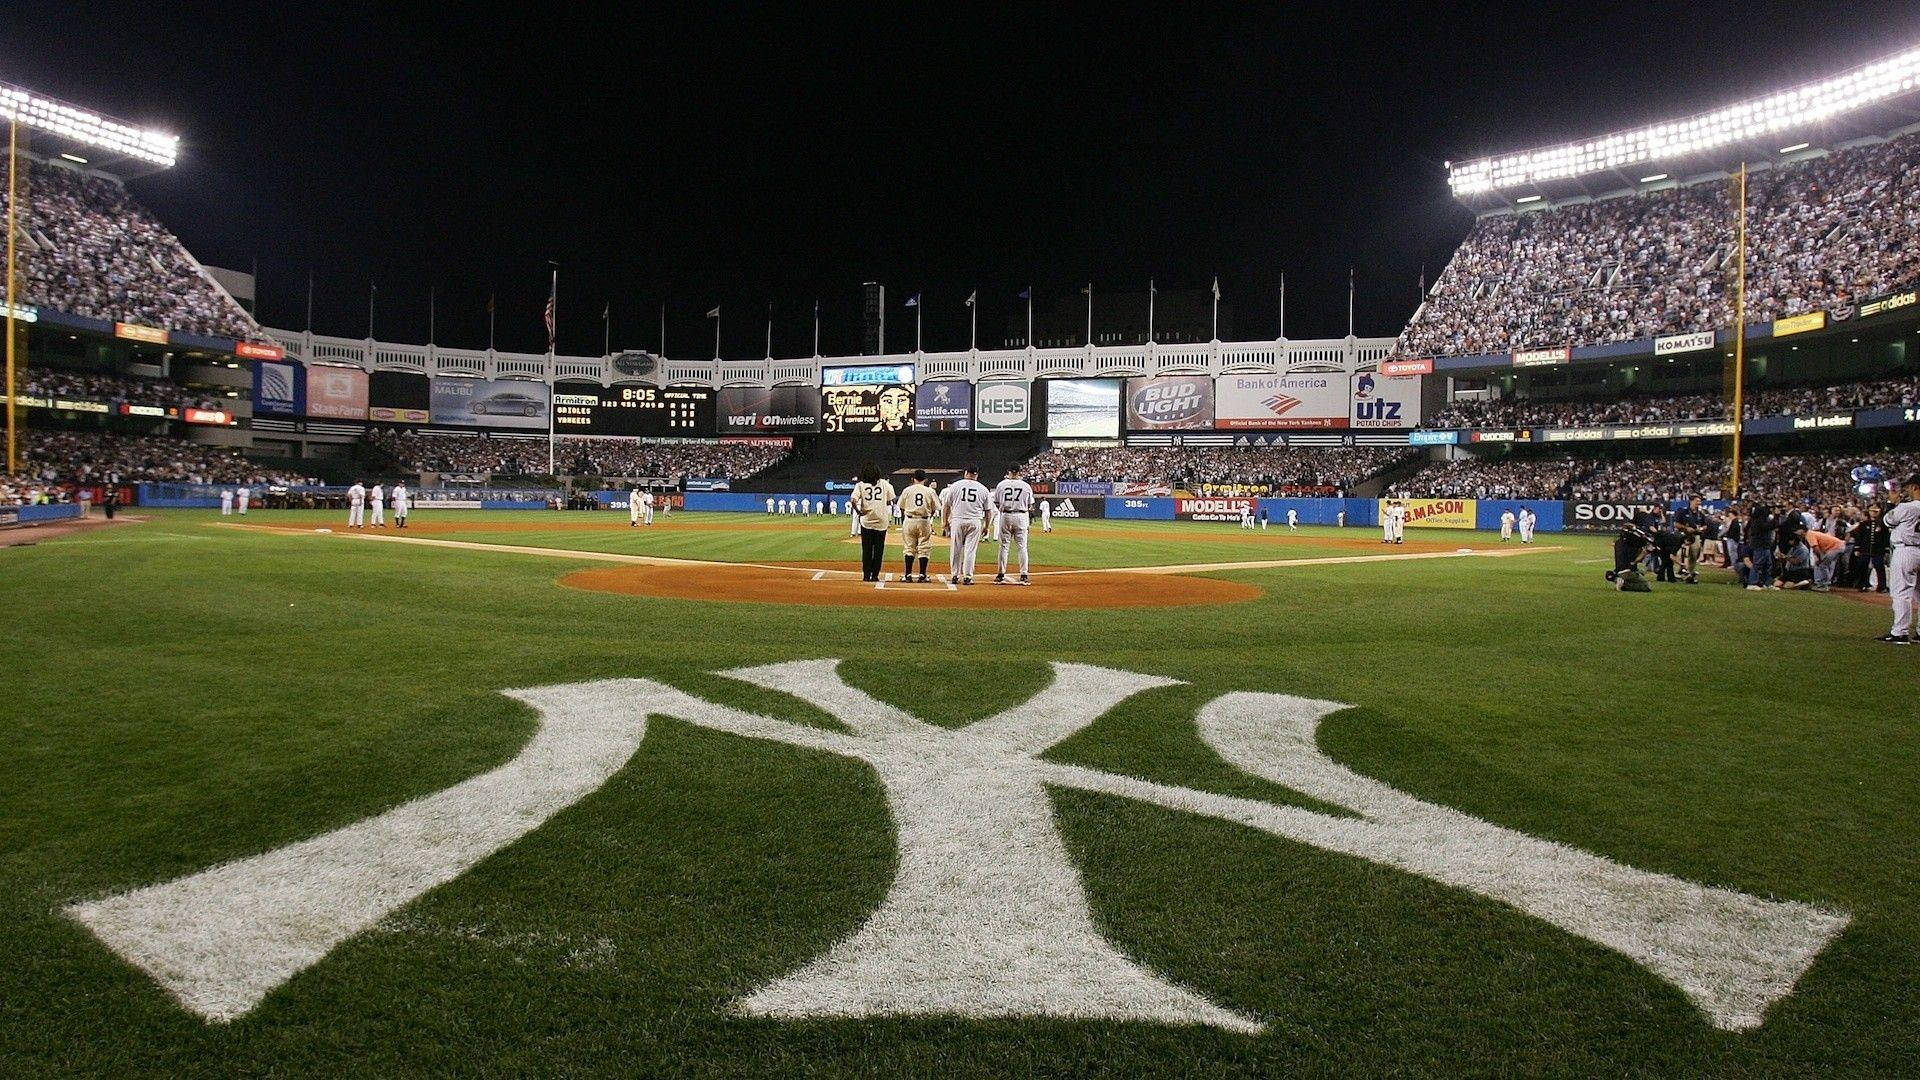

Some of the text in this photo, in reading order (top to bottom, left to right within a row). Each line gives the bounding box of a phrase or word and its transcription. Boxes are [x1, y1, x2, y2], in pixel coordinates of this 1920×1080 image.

[1881, 292, 1916, 310] adidas
[1657, 335, 1712, 351] KOMATSU
[1516, 350, 1566, 362] MODELL'S
[1397, 363, 1426, 372] TOYOTA
[1237, 379, 1327, 389] Bank of America
[435, 386, 472, 396] MALIBU
[623, 389, 656, 401] 8:05
[1145, 383, 1196, 401] BUD
[555, 396, 597, 405] Armitron
[828, 394, 863, 405] Bernie
[1139, 395, 1202, 414] LIGHT
[917, 407, 969, 415] metlife.com
[982, 399, 1024, 413] HESS
[1357, 398, 1402, 419] utz
[557, 416, 591, 424] YANKEES
[780, 415, 815, 425] wireless
[1817, 415, 1852, 427] Locker
[1480, 432, 1515, 441] KYOCERA
[1566, 424, 1736, 440] adidas adidas adidas
[864, 487, 882, 500] 32
[961, 487, 977, 502] 15
[1004, 487, 1023, 501] 27
[1061, 482, 1080, 495] AIG
[610, 501, 628, 509] 399
[915, 493, 924, 507] 8
[1182, 499, 1250, 513] MODELL'S
[1052, 508, 1080, 518] adidas
